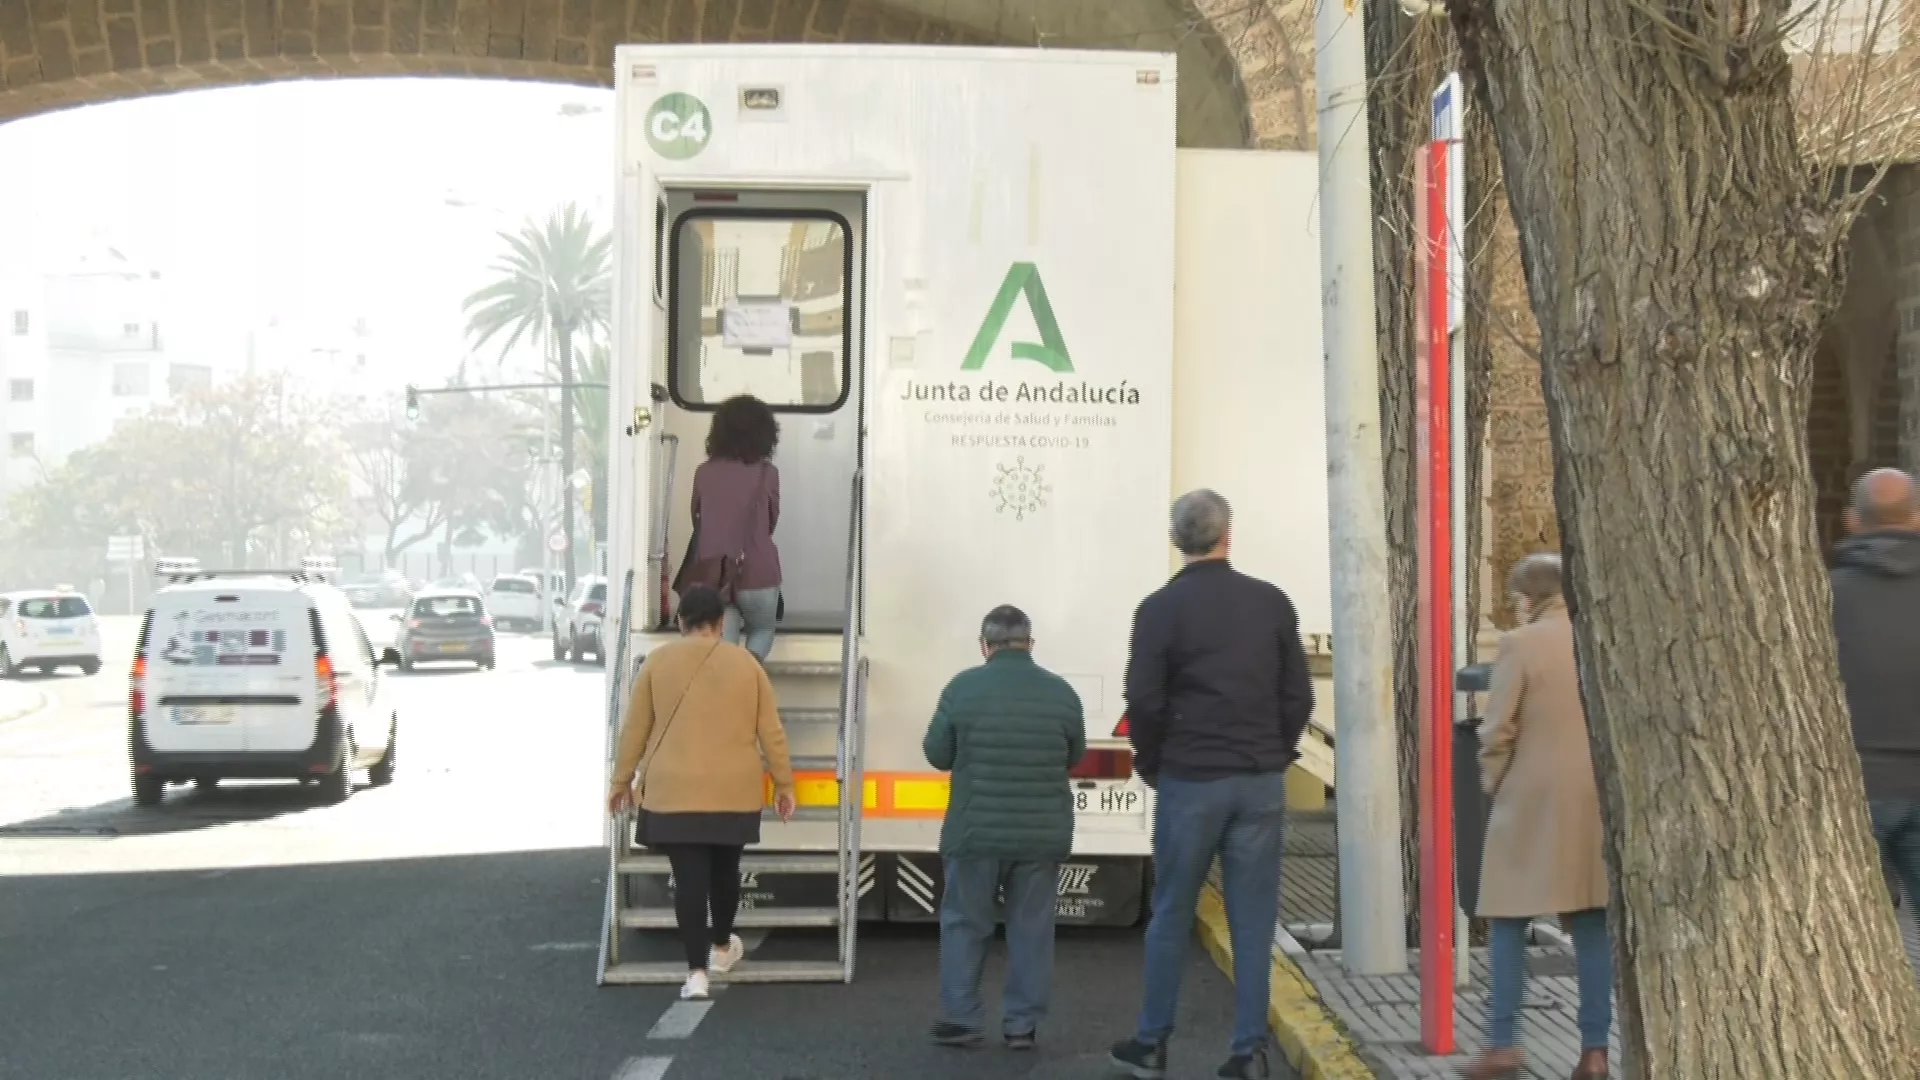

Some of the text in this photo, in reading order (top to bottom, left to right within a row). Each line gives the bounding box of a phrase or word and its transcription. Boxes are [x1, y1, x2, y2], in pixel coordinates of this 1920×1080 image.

[651, 111, 707, 142] C4
[900, 379, 1140, 404] Junta de Andalucía
[994, 411, 1011, 425] de
[1014, 412, 1050, 426] Salud
[1054, 415, 1061, 428] y
[1064, 412, 1117, 427] Familias
[951, 433, 1090, 449] RESPUESTA COVID-19
[1101, 788, 1138, 811] HYP
